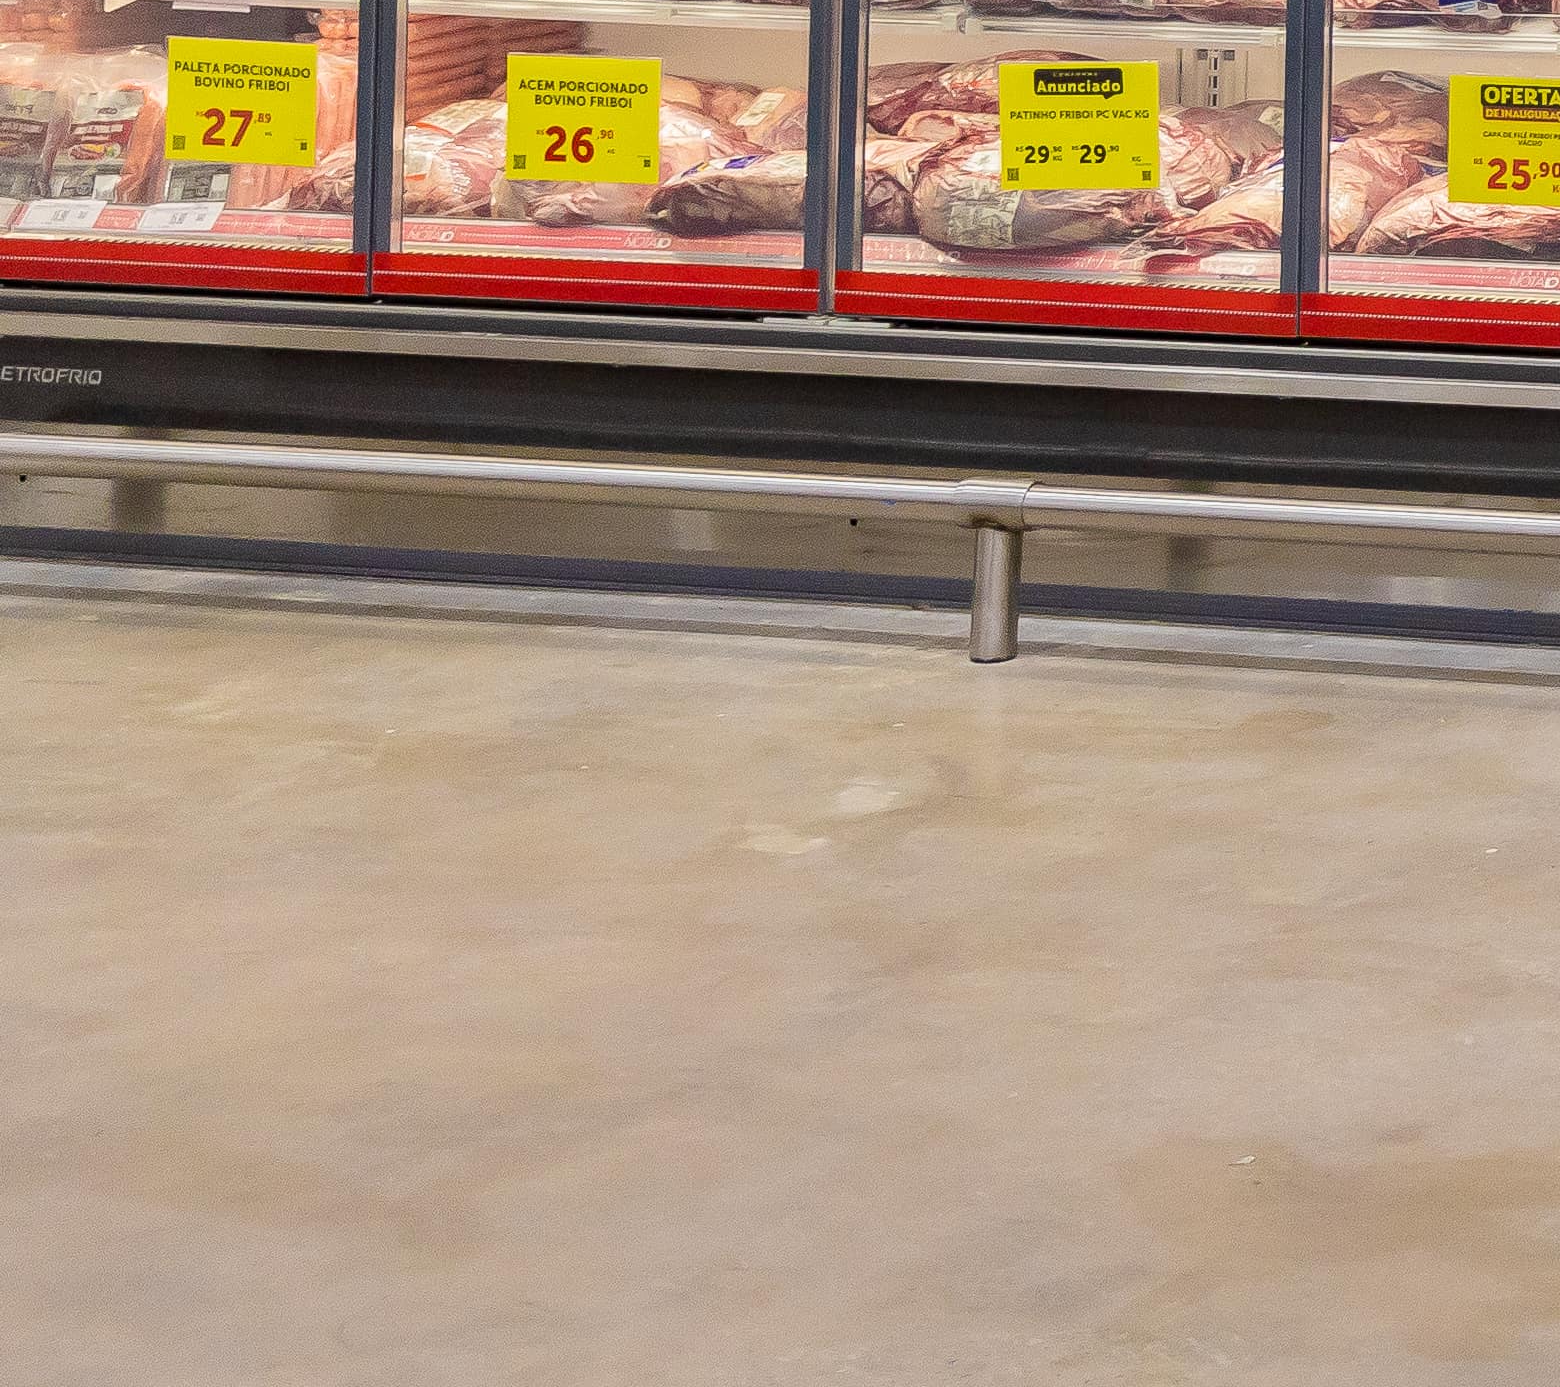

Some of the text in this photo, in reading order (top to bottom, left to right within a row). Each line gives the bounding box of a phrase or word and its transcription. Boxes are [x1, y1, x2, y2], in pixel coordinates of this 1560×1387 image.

[174, 61, 310, 79] PALETA PORCIONADO
[194, 76, 290, 92] BOVINO FRIBOI
[519, 80, 648, 95] ACEM PORCIONADO
[1037, 80, 1121, 93] Anunciado
[535, 95, 632, 109] BOVINO FRIBOI
[1010, 110, 1056, 119] PATINHO
[1060, 110, 1093, 119] FRIBOI
[1111, 109, 1132, 118] VAC
[1134, 109, 1149, 118] KG
[1486, 109, 1501, 117] DE
